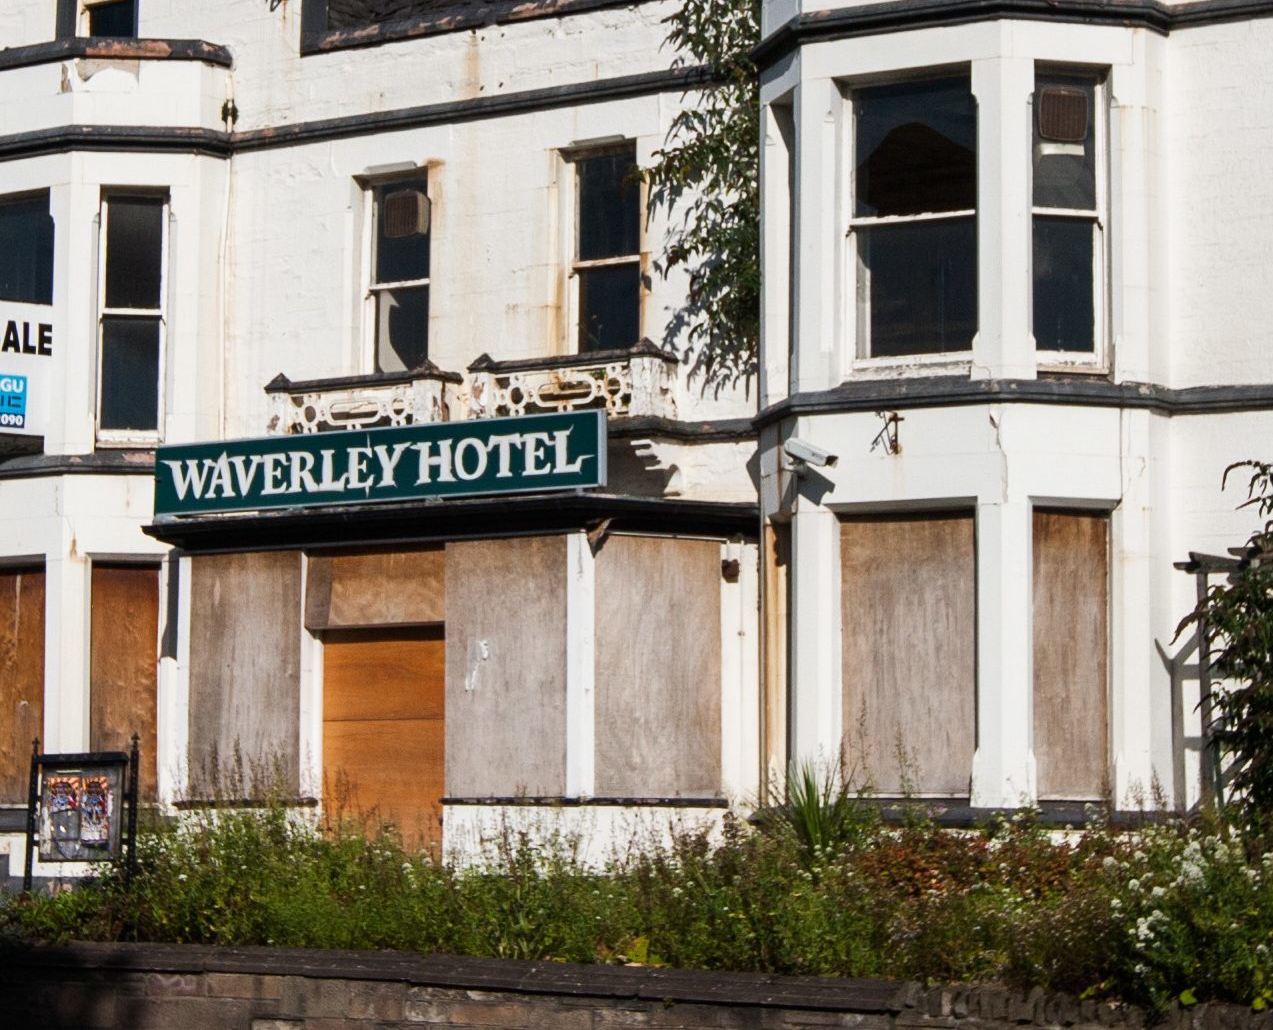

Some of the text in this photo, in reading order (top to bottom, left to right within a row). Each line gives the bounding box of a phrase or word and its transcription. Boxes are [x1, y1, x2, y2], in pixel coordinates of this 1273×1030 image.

[0, 320, 53, 357] ALE
[0, 377, 24, 394] GU
[0, 413, 24, 426] 090
[160, 424, 595, 502] WAVERLEY HOTEL
